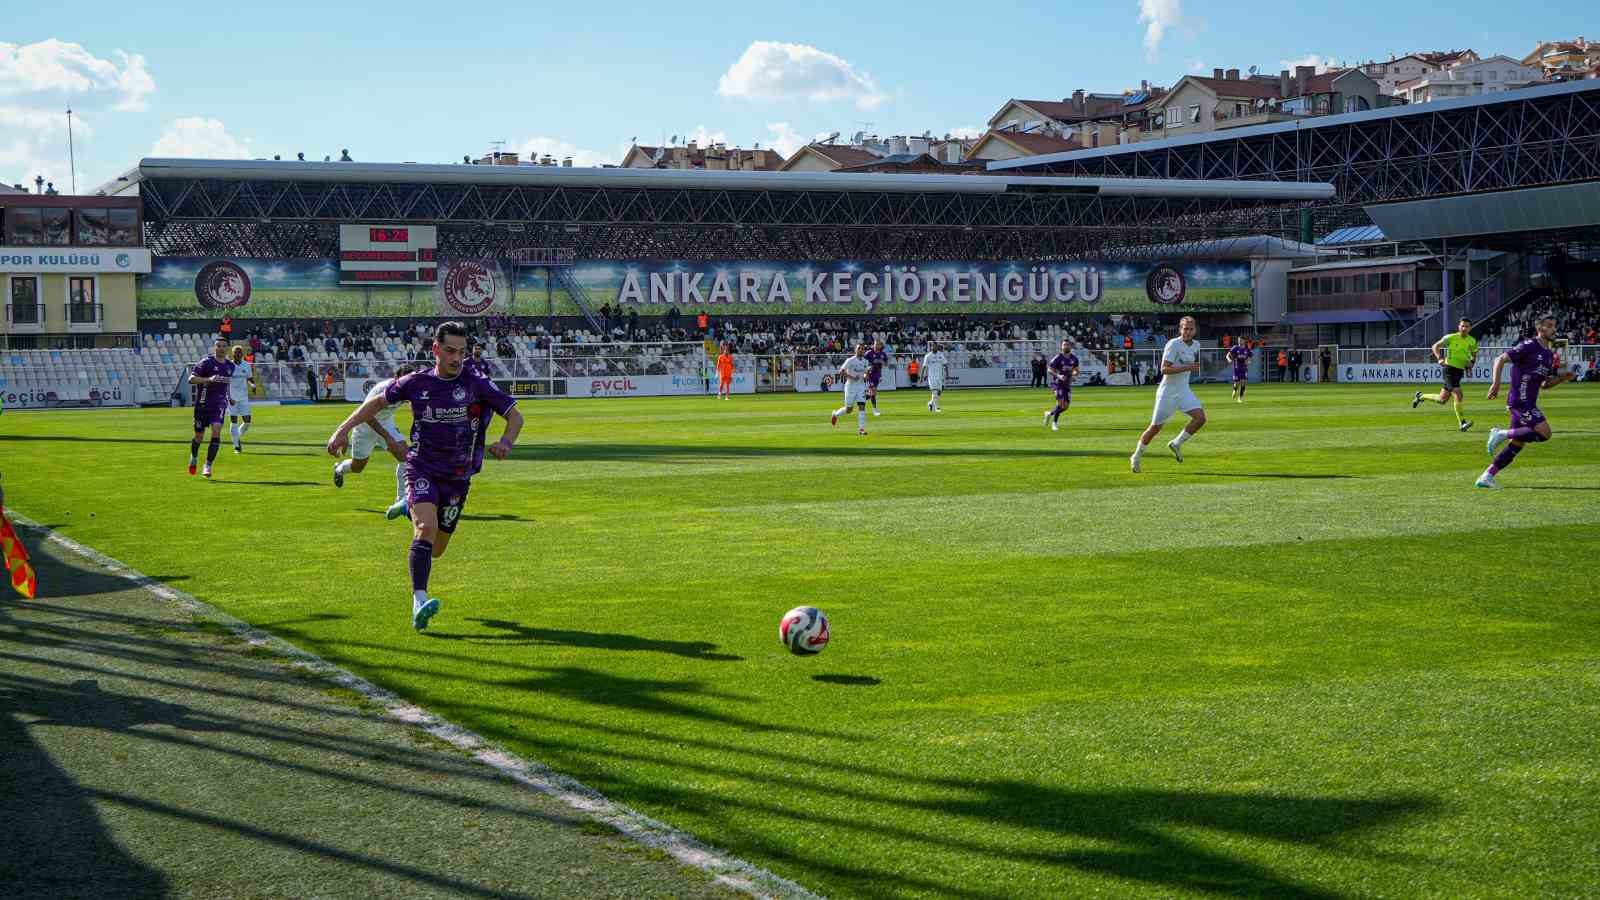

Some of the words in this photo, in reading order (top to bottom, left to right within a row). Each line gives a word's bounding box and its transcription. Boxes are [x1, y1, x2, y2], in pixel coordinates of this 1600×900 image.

[39, 253, 100, 265] KULÜBÜ
[618, 271, 792, 303] ANKARA
[805, 265, 1101, 310] KEÇİÖRENGÜCÜ
[1361, 367, 1402, 379] ANKARA
